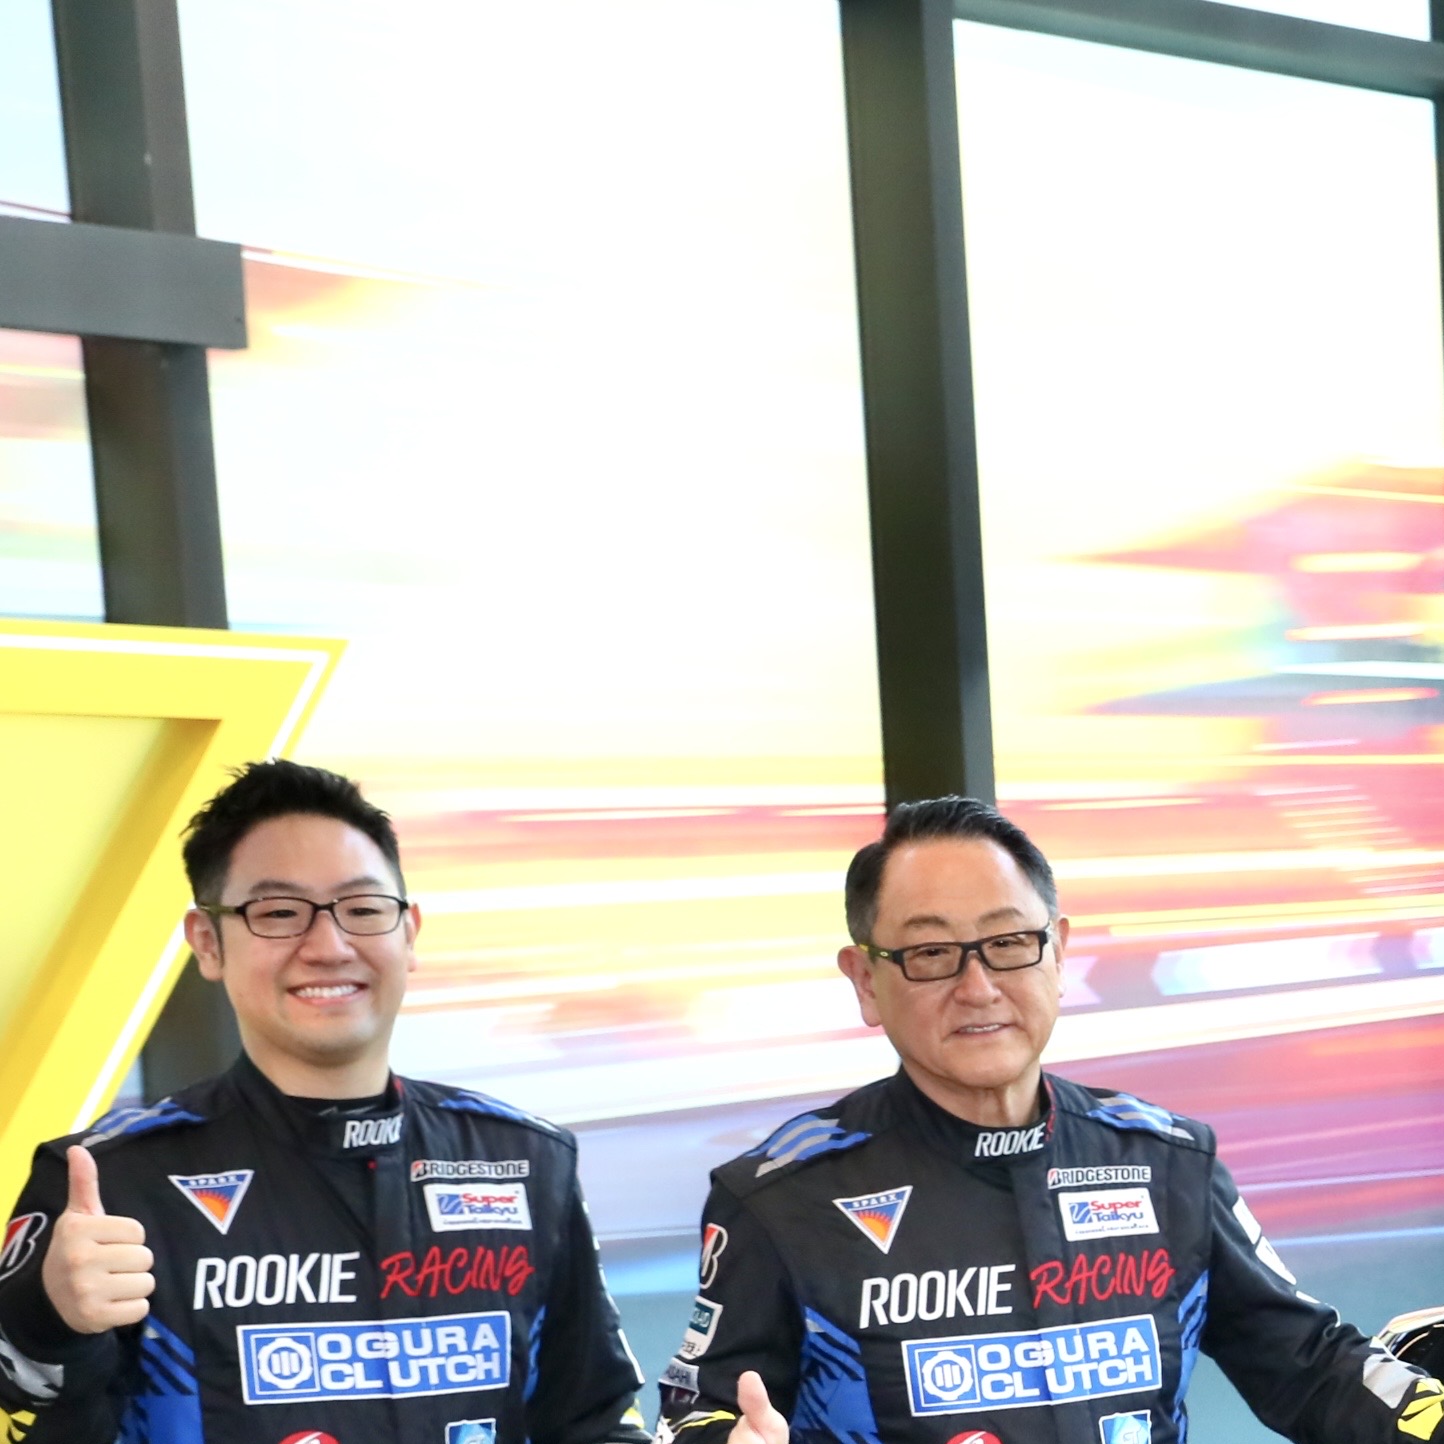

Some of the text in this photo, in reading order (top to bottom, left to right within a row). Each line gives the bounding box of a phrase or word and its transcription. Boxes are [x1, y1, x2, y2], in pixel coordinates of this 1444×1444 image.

[974, 1122, 1046, 1157] ROOKIE
[412, 1161, 529, 1181] BRIDGESTONE
[1048, 1167, 1150, 1187] BRIDGESTONE
[462, 1193, 518, 1207] Super
[852, 1194, 898, 1209] SPARX
[1090, 1200, 1142, 1213] Super
[1092, 1210, 1144, 1223] Taikyu
[193, 1245, 535, 1310] ROOKIE RACING
[859, 1248, 1176, 1329] ROOKIE RACING
[317, 1323, 500, 1361] OGURA
[977, 1327, 1150, 1372] OGURA
[319, 1352, 502, 1391] CLUTCH
[981, 1355, 1153, 1401] CLUTCH
